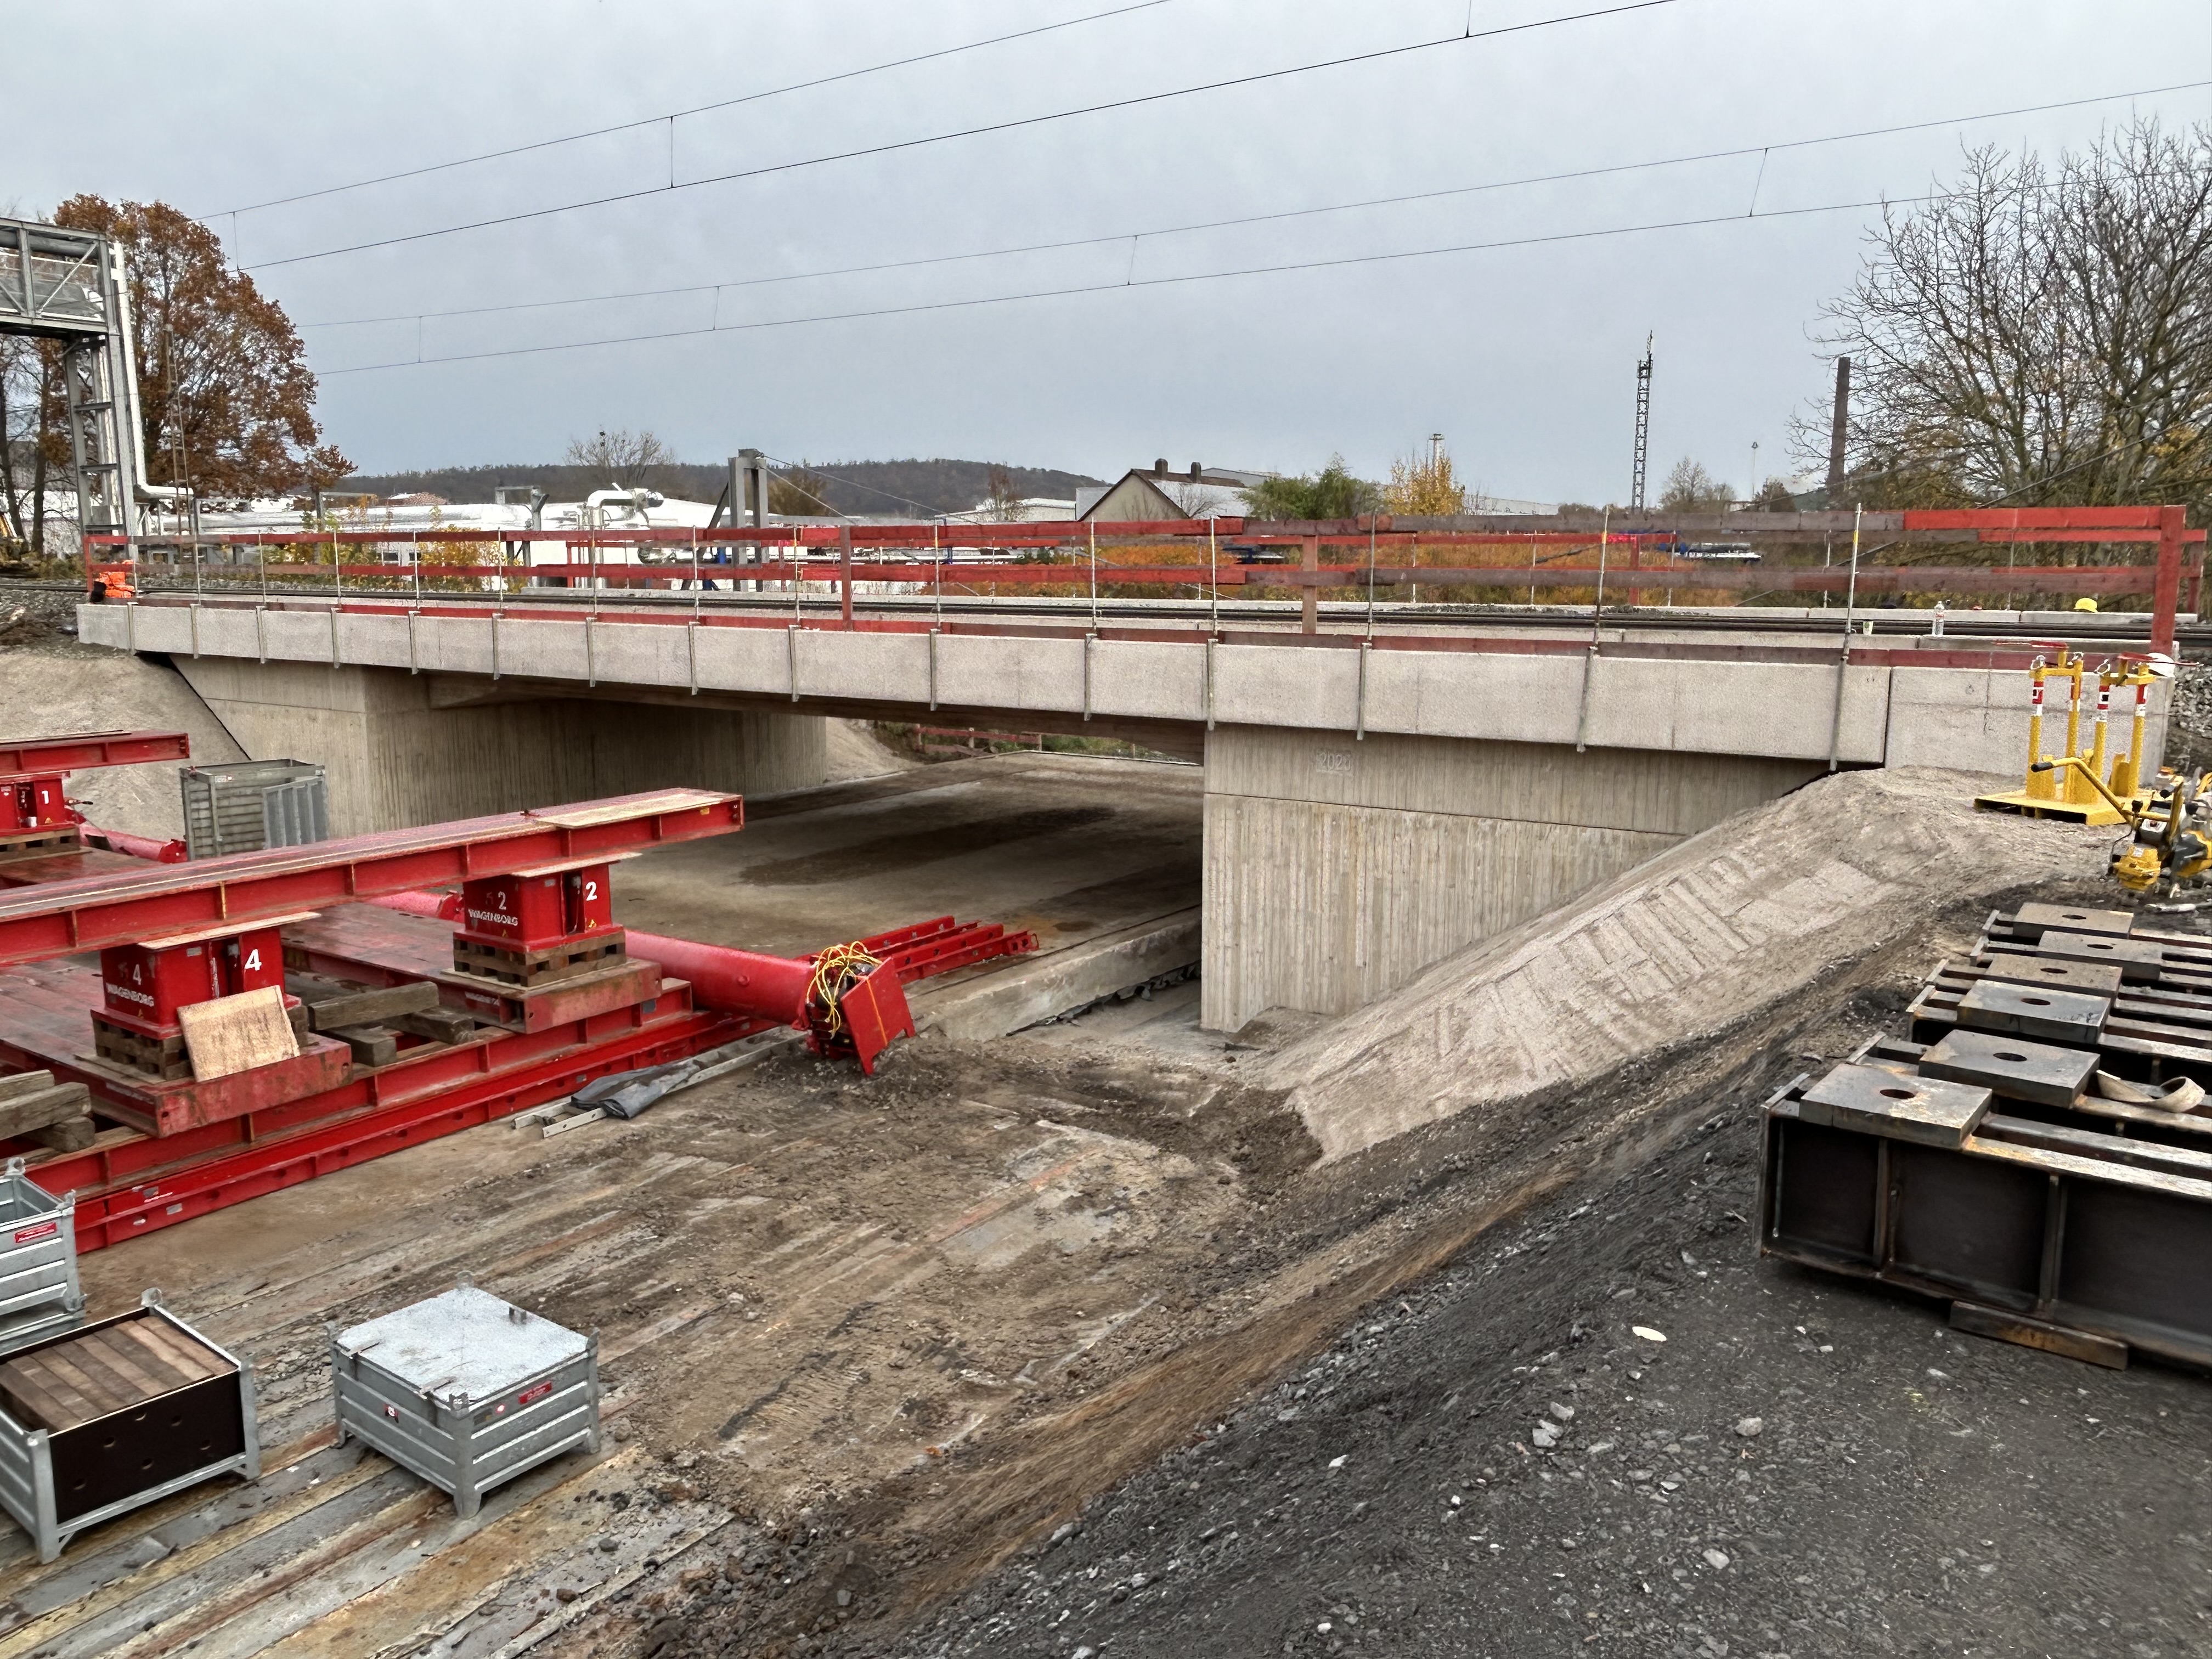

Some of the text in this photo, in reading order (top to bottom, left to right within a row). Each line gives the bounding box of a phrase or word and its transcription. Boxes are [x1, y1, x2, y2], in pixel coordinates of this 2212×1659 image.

[42, 790, 49, 804] 1
[498, 891, 507, 910] 2
[585, 881, 597, 901] 2
[244, 949, 262, 971] 4
[132, 964, 142, 985] 4
